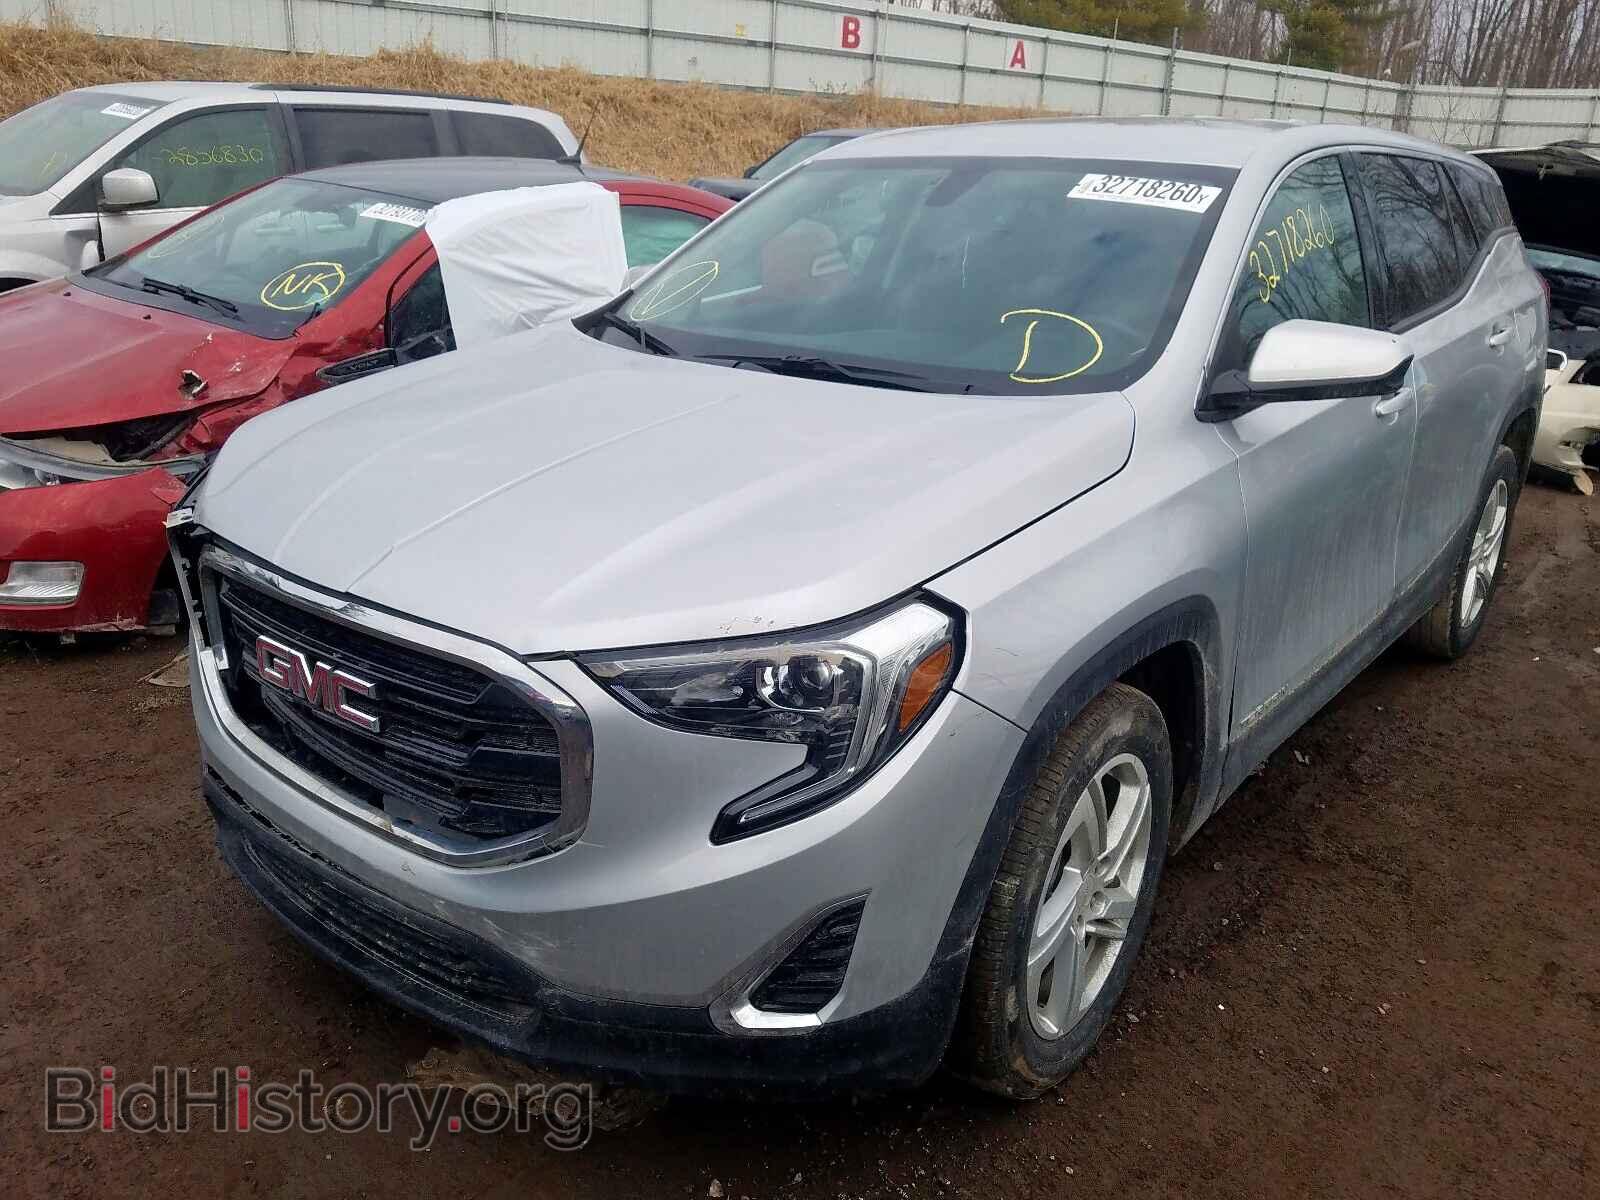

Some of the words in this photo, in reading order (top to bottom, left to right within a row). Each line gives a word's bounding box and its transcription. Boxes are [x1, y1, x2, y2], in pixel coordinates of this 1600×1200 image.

[841, 15, 861, 49] B
[1009, 39, 1027, 70] A
[1249, 200, 1335, 304] 32718260
[270, 272, 340, 298] NK
[1000, 308, 1103, 383] D
[256, 635, 380, 733] GMC
